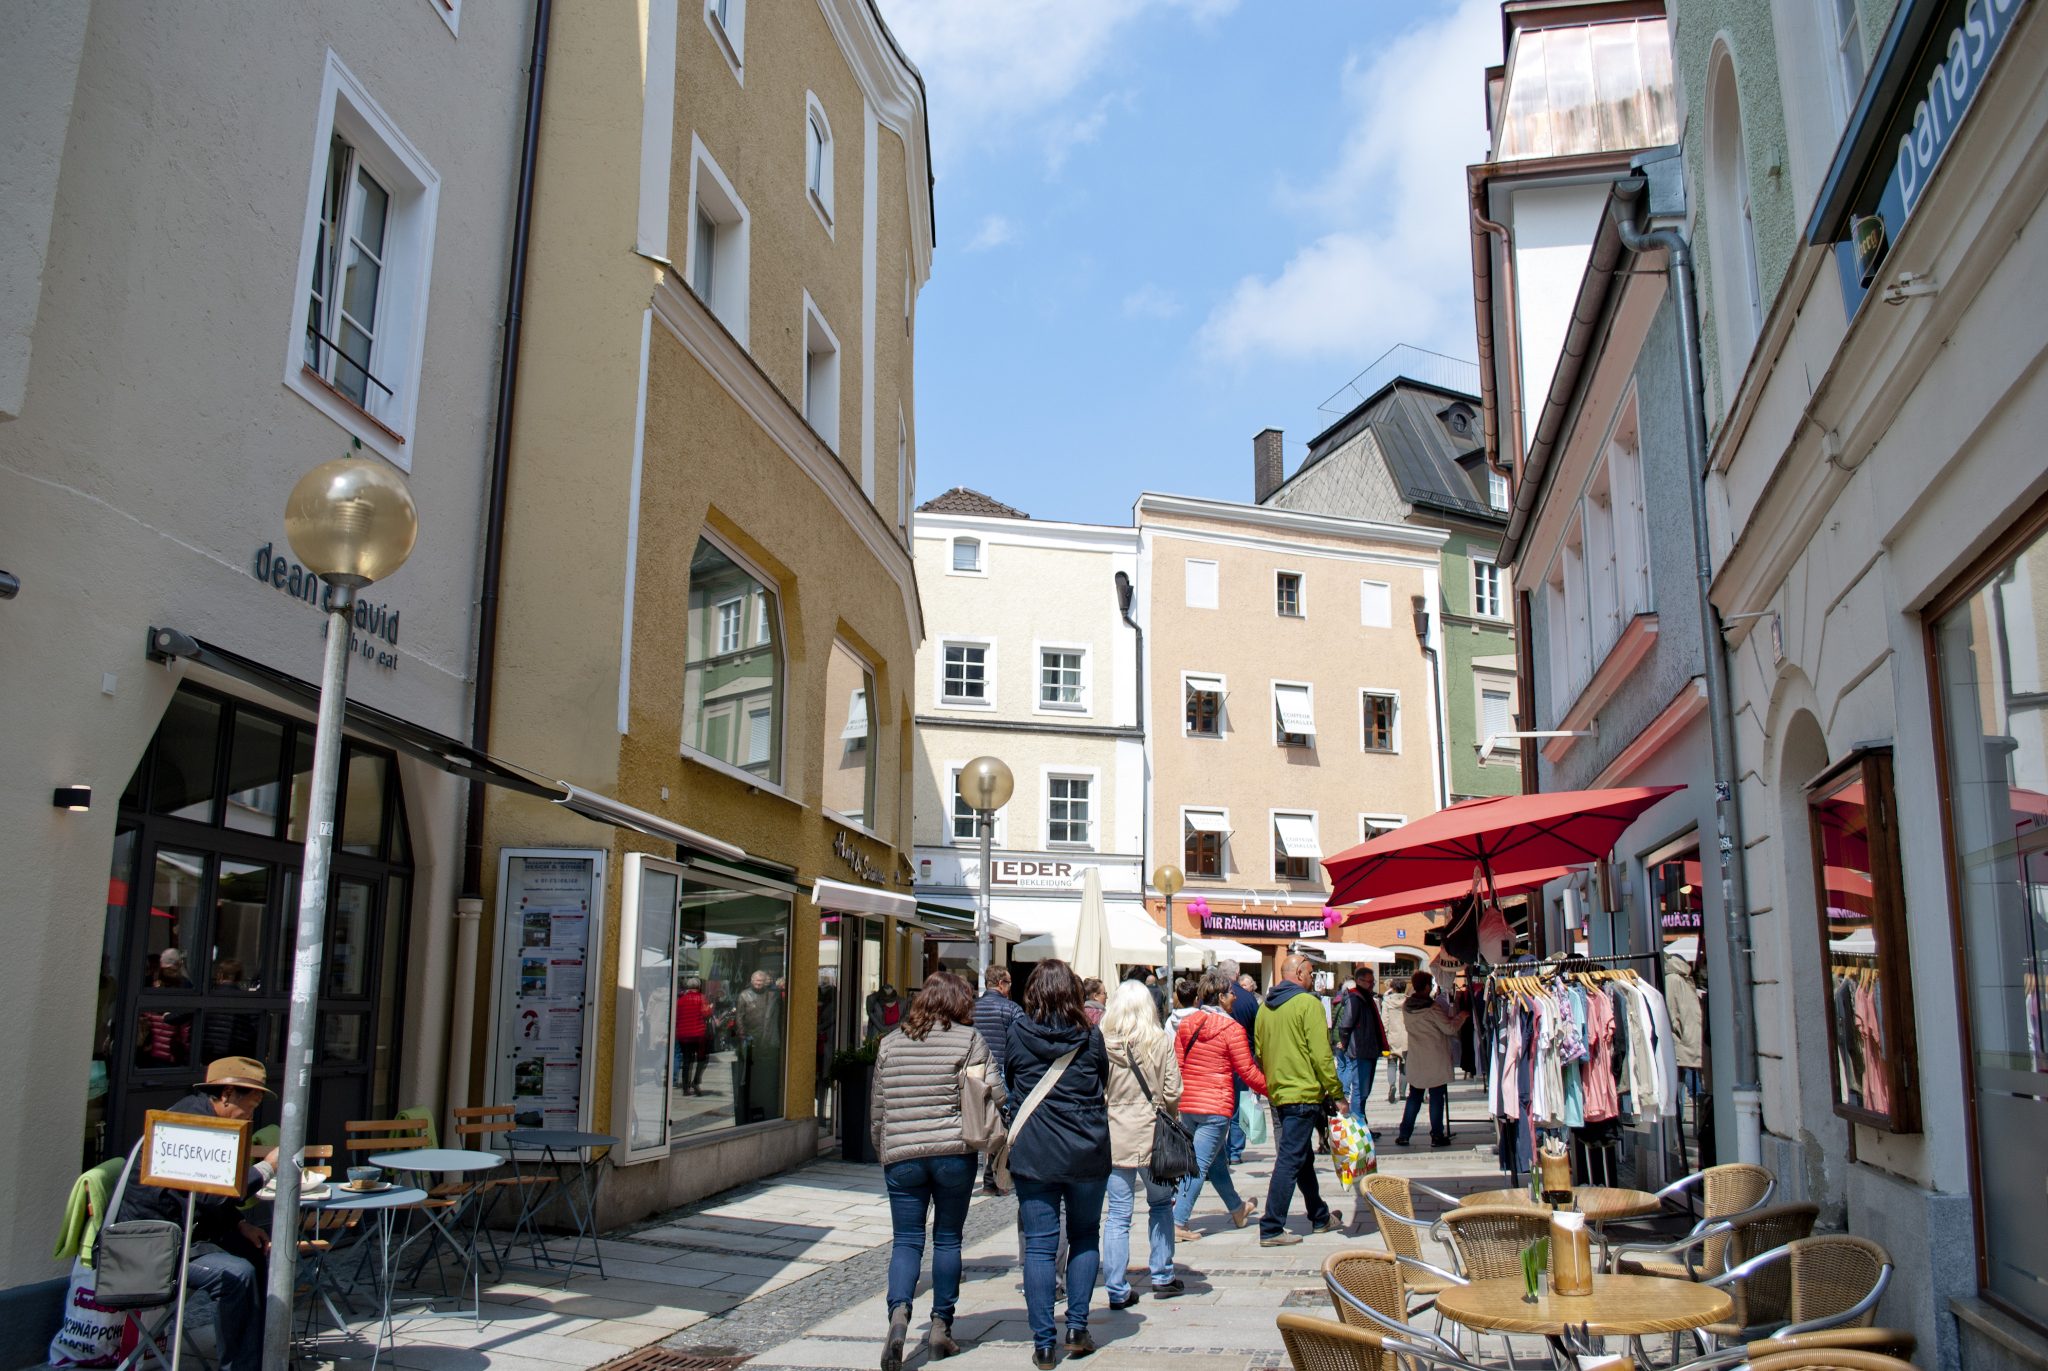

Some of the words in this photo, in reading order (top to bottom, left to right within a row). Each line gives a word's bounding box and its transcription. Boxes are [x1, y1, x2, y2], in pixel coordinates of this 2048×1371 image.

[1898, 0, 2011, 221] panasi
[378, 650, 399, 671] eat
[991, 861, 1072, 885] LEDER
[1020, 879, 1072, 887] BEKLEIDUNG
[1203, 916, 1223, 930] WIR
[1224, 915, 1265, 931] RÄUMEN
[1266, 919, 1296, 932] UNSER
[1297, 920, 1325, 932] LAGER
[161, 1141, 232, 1164] SELFSERVICE!
